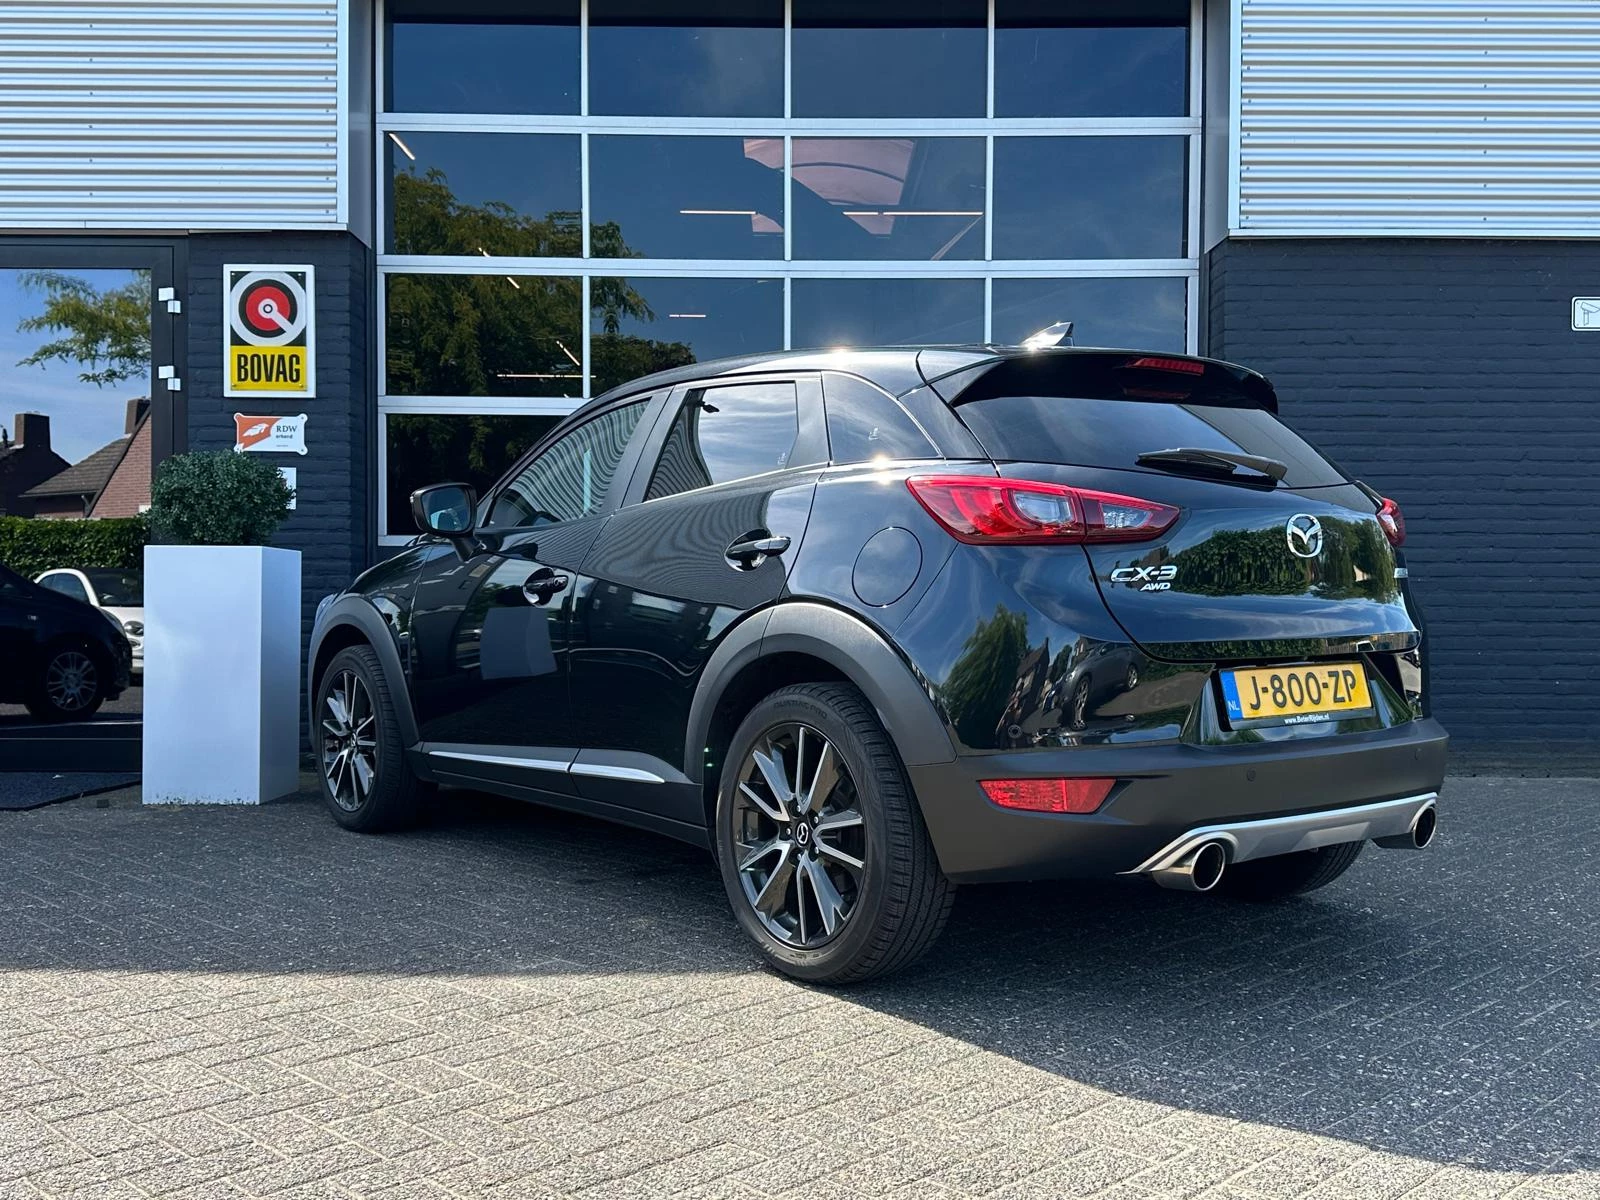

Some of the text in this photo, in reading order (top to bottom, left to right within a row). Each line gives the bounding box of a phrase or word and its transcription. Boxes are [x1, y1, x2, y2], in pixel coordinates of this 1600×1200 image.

[237, 353, 300, 383] BOVAG
[1111, 565, 1178, 582] CX-3
[1140, 582, 1171, 591] AWD
[1250, 669, 1356, 710] J-800-ZP
[1227, 701, 1240, 711] NL
